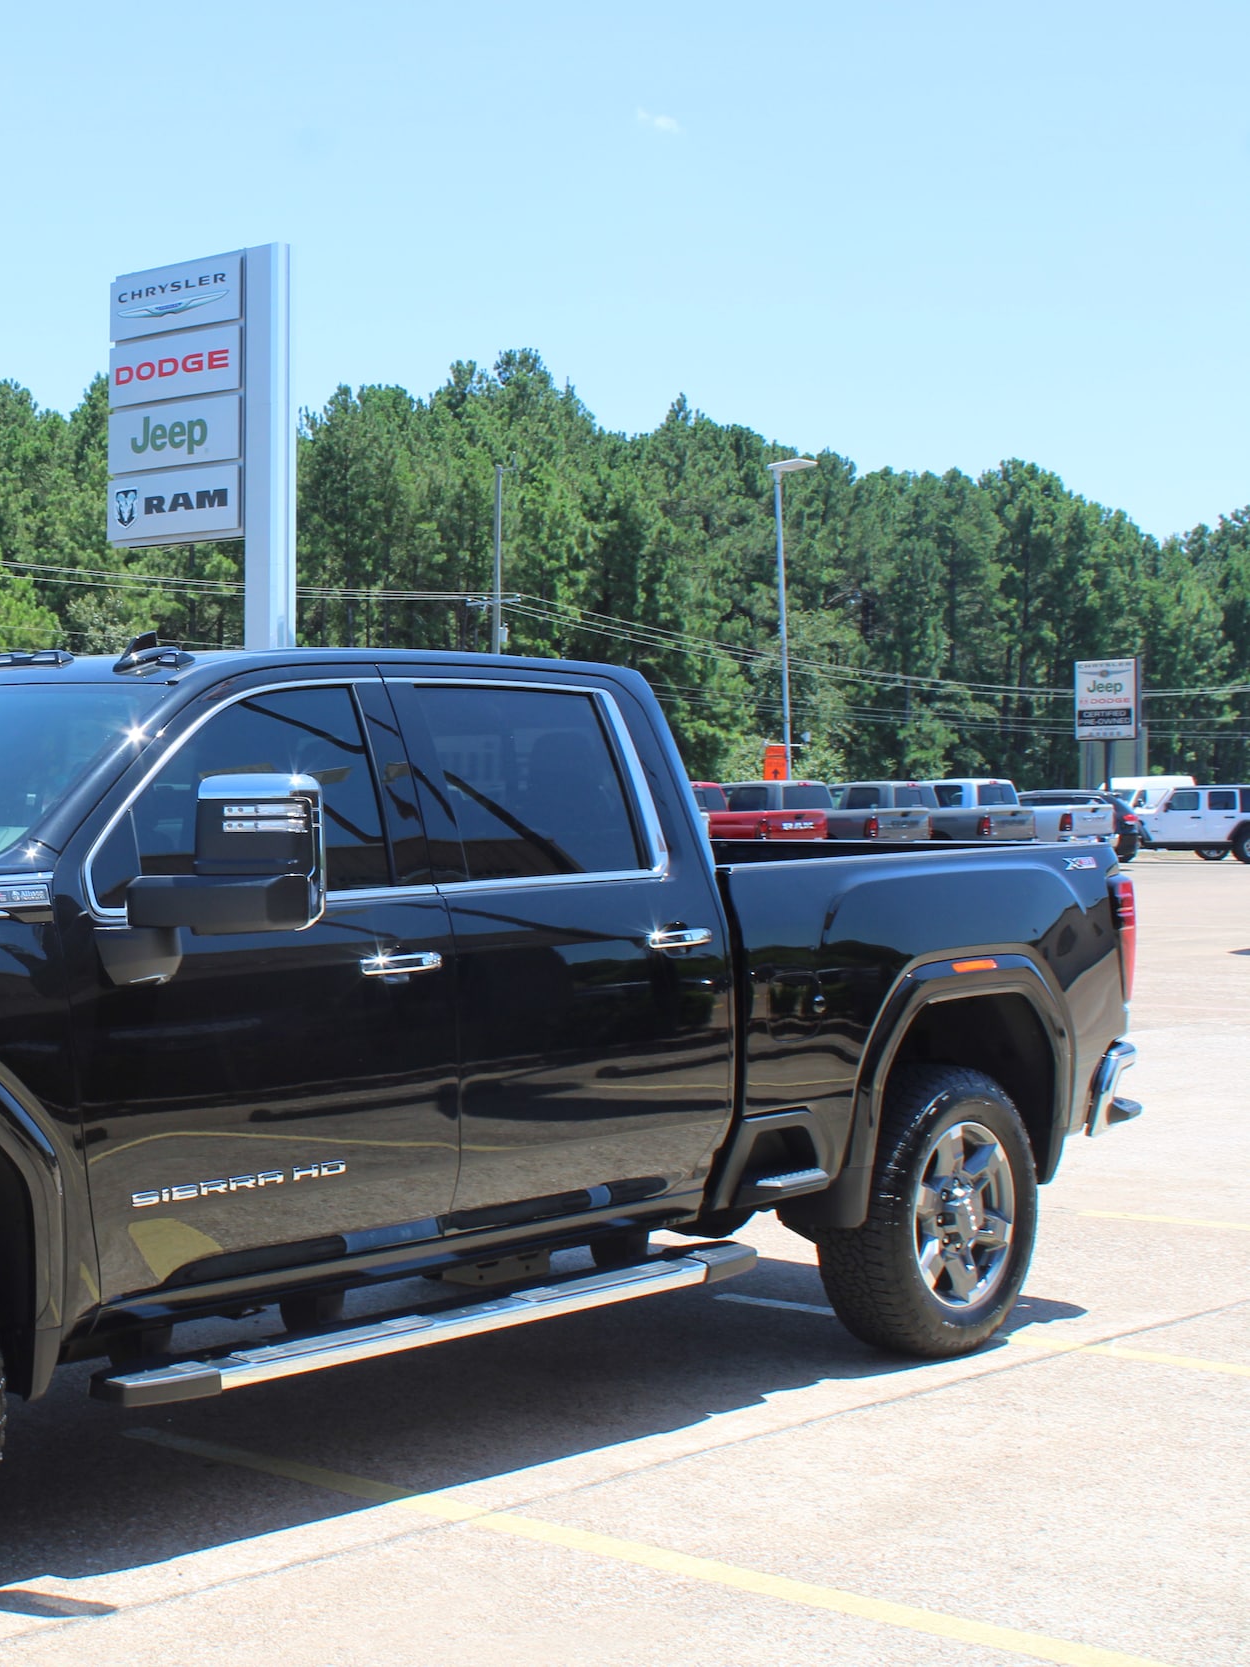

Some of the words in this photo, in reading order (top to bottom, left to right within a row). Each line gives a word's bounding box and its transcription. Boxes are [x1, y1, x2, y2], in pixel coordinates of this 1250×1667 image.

[117, 273, 226, 303] CHRYSLER
[115, 348, 230, 386] DODGE
[130, 416, 208, 455] Jeep
[144, 487, 229, 516] RAM
[1078, 661, 1132, 669] CHRYSLER
[1086, 680, 1124, 694] Jeep
[1090, 697, 1131, 705] DODGE
[1078, 718, 1131, 726] PRE-OWNED
[1082, 709, 1127, 718] CERTIFIED
[130, 1169, 285, 1208] SIERRA
[292, 1159, 347, 1182] HD
